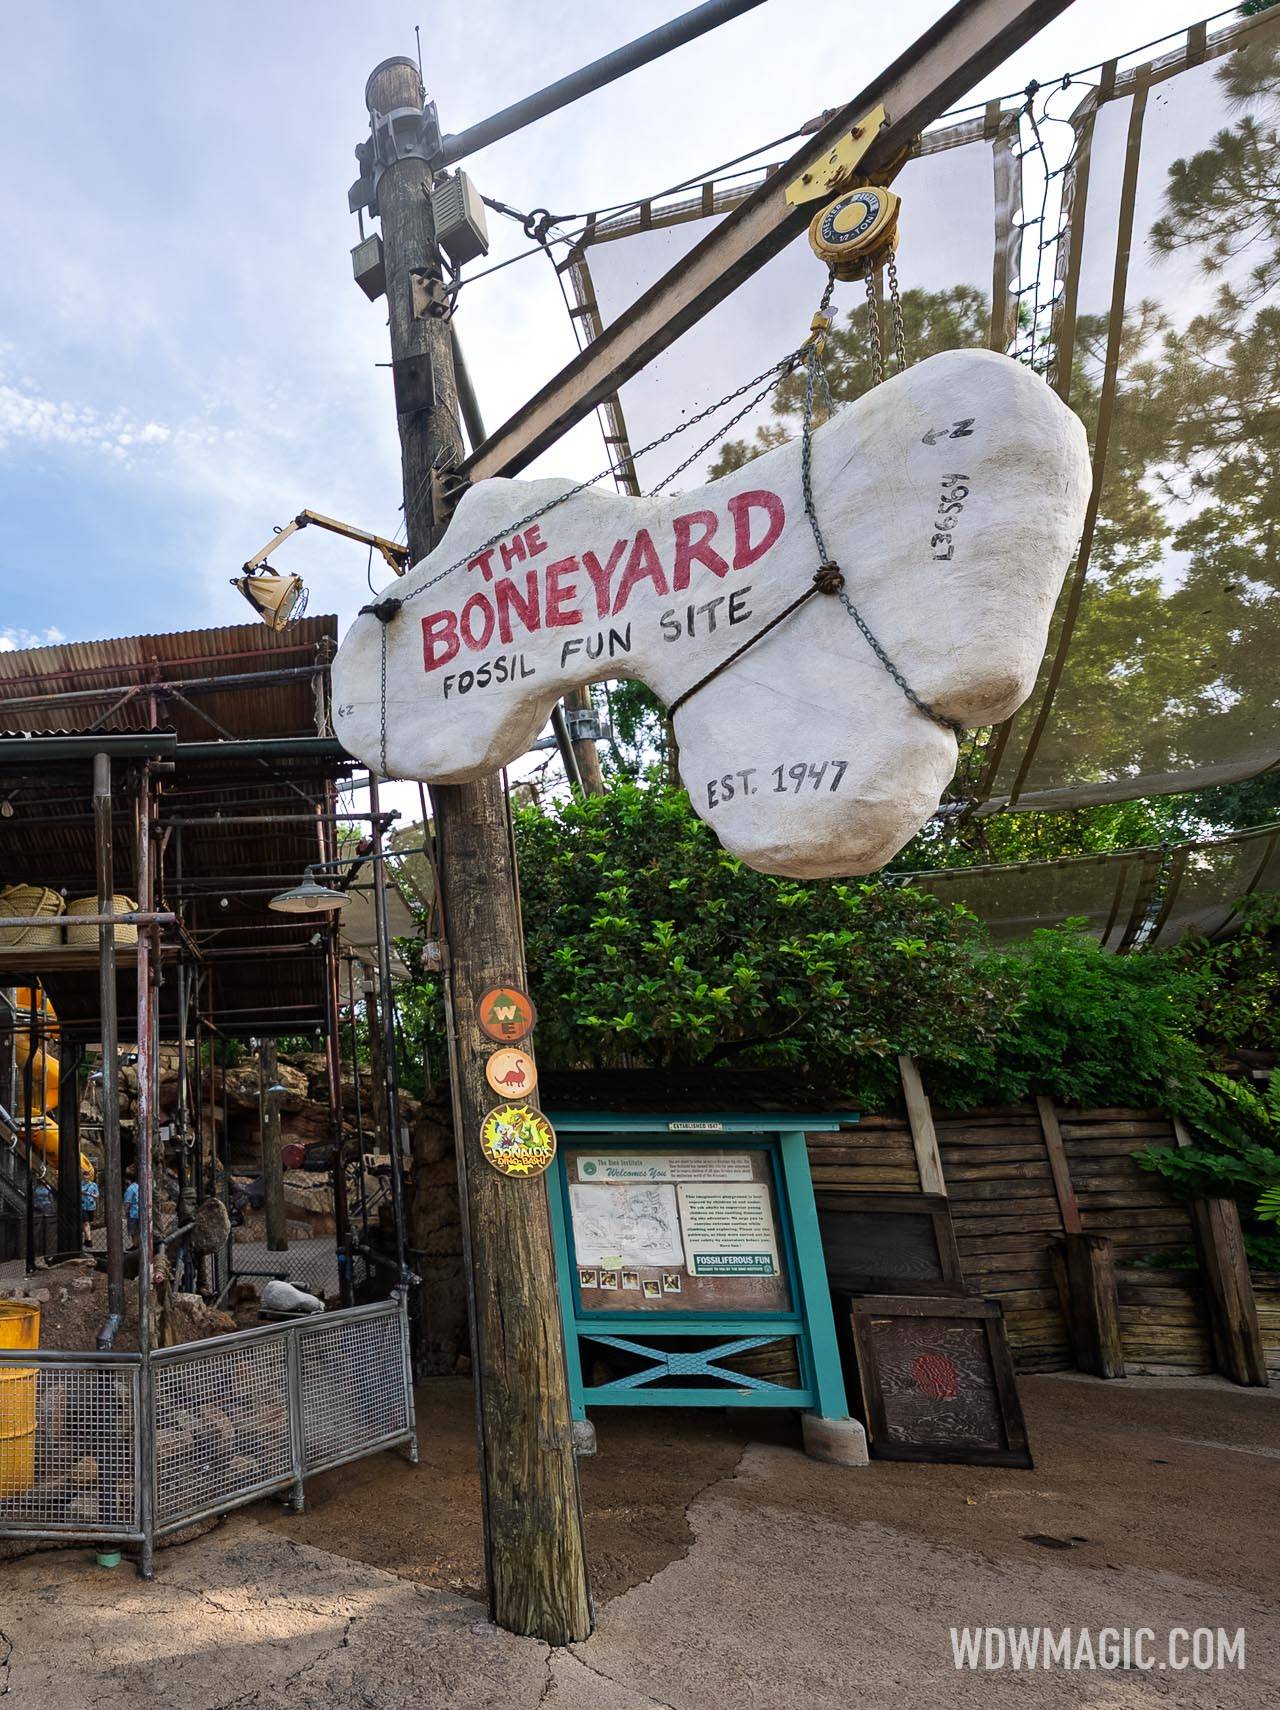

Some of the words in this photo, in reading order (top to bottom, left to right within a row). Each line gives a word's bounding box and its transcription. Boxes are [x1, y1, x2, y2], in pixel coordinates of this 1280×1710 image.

[930, 473, 971, 561] L36564
[467, 524, 549, 582] THE
[421, 489, 787, 672] BONEYARD
[443, 652, 536, 699] FOSSIL
[561, 621, 632, 668] FUN
[662, 586, 753, 643] SITE
[707, 767, 757, 809] EST.
[771, 760, 850, 796] 1947
[493, 1004, 517, 1021] W
[492, 1145, 553, 1159] DONALD'S
[605, 1167, 648, 1177] Welcomes
[649, 1167, 667, 1179] You
[696, 1256, 753, 1265] FOSSILIFEROUS
[754, 1256, 771, 1264] FUN
